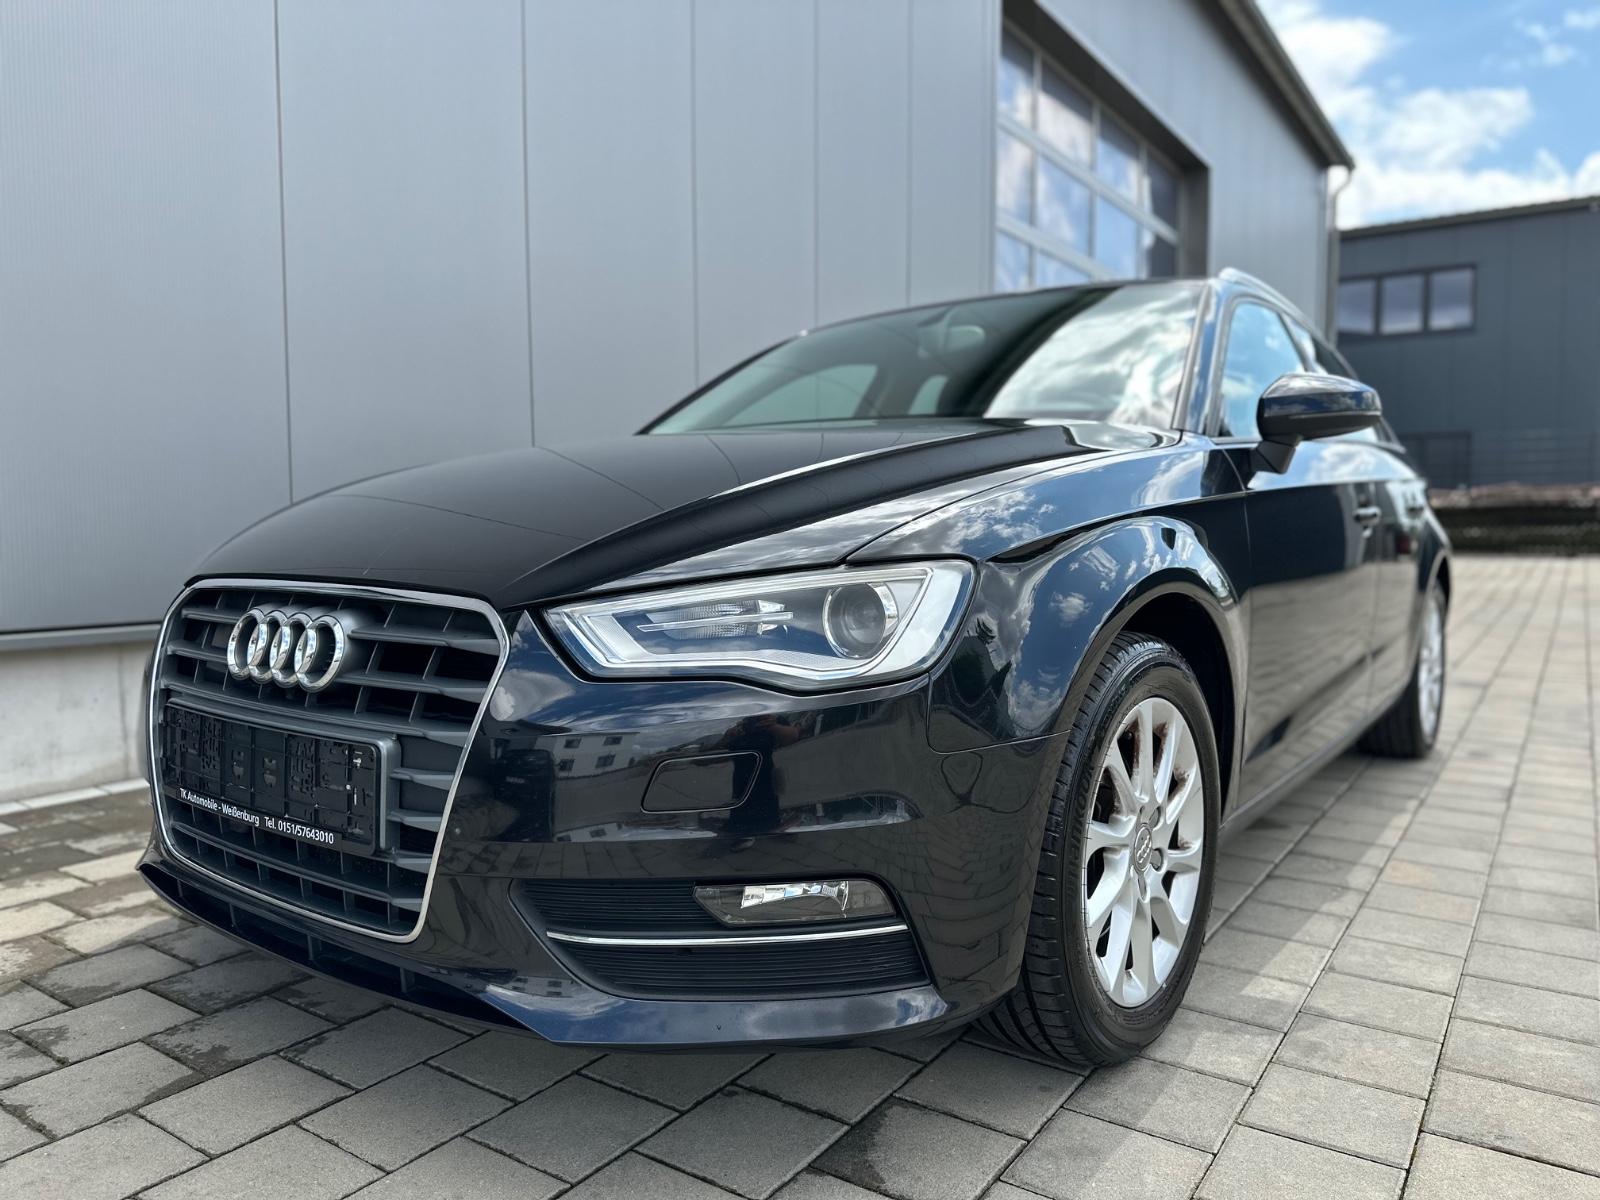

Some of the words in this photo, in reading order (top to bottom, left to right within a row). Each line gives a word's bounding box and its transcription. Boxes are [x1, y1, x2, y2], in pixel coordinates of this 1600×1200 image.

[179, 787, 187, 800] TK
[187, 791, 218, 811] Automobile
[222, 803, 260, 827] Weißenburg
[264, 816, 277, 830] Tel.
[278, 819, 334, 845] 0151/57643010
